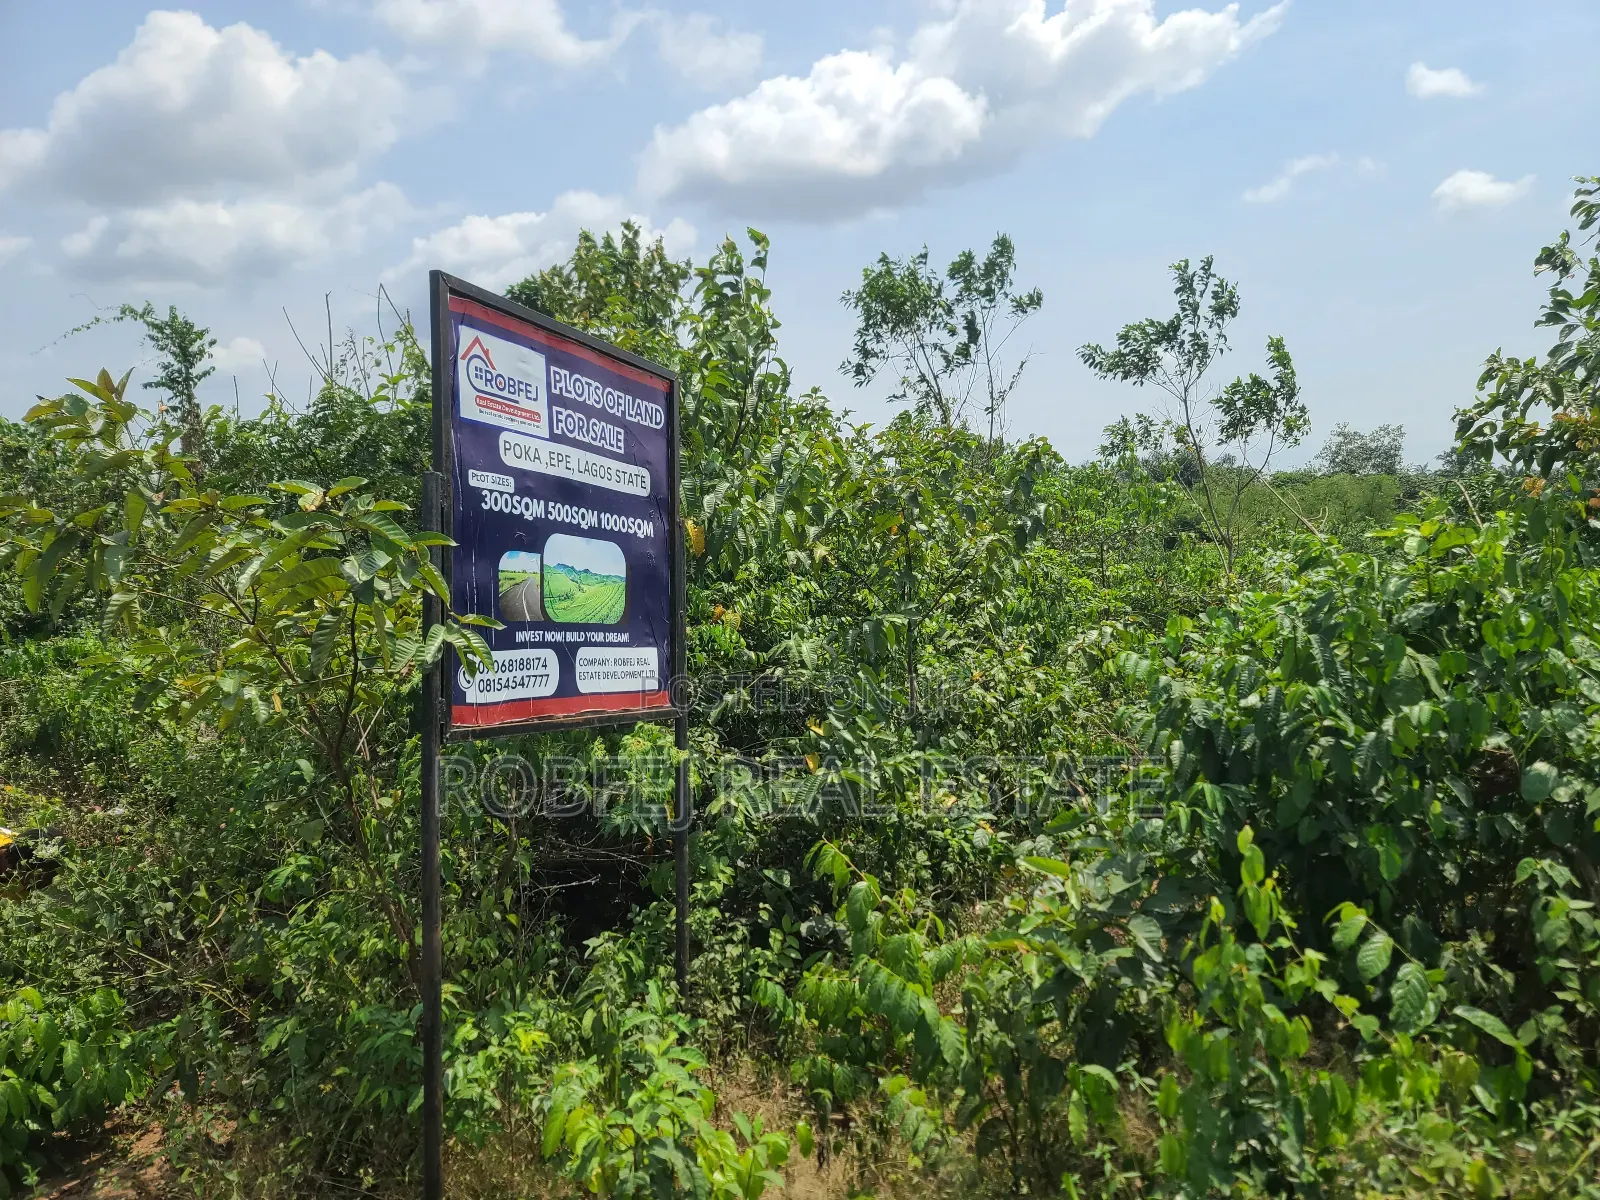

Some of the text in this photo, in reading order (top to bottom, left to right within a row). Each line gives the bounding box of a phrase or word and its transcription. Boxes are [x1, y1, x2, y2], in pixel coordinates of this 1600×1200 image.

[484, 369, 538, 402] ROBFEJ
[551, 366, 664, 430] PLOTS OF LAND
[553, 406, 589, 442] FOR
[589, 418, 624, 454] SALE
[503, 440, 542, 464] POKA
[577, 458, 612, 482] LAGOS
[615, 469, 647, 489] STATE
[472, 472, 512, 487] PLOT SIZES:
[481, 490, 654, 538] 300SQM 500SQM 1000SQM
[515, 631, 629, 642] INVEST NOW! BUILD YOUR DREAM!
[578, 657, 650, 667] COMPANY: ROBFEJ REAL
[578, 670, 656, 680] ESTATE DEVELOPMENT LTD
[478, 674, 550, 693] 08154547777
